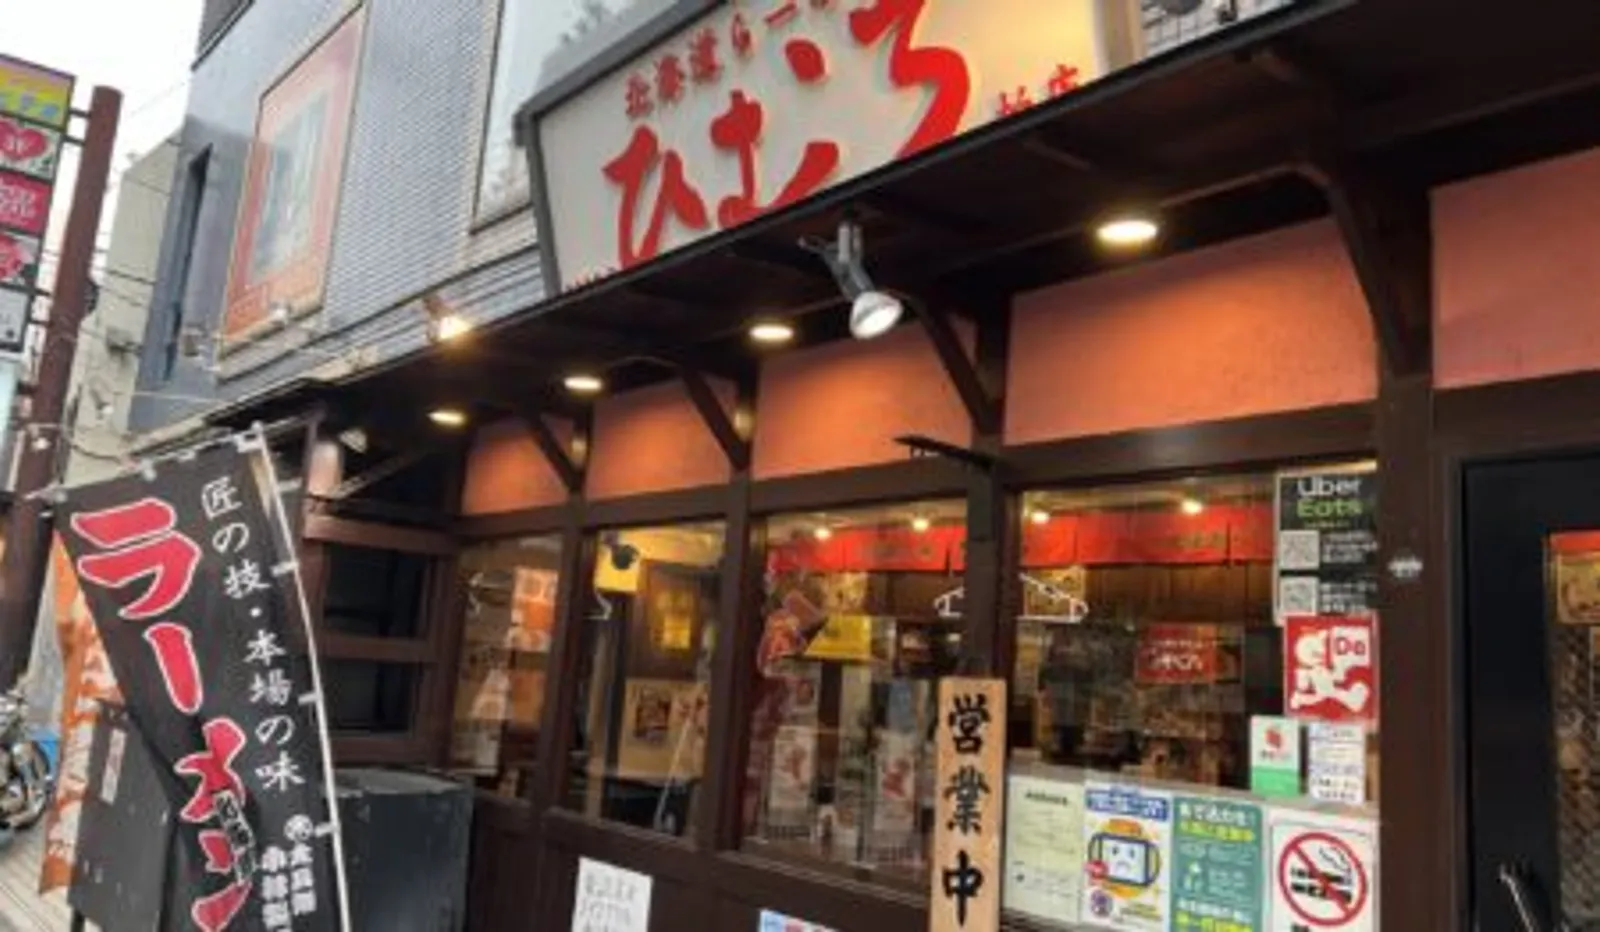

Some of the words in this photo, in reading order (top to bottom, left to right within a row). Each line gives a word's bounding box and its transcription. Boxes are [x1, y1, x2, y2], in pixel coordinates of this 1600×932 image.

[625, 0, 830, 119] 北海道らー
[1297, 475, 1361, 496] Uber
[1297, 497, 1363, 517] Eats
[70, 497, 252, 932] ラーメン
[201, 475, 305, 792] 匠の技・本場の味
[942, 693, 991, 928] 営業中
